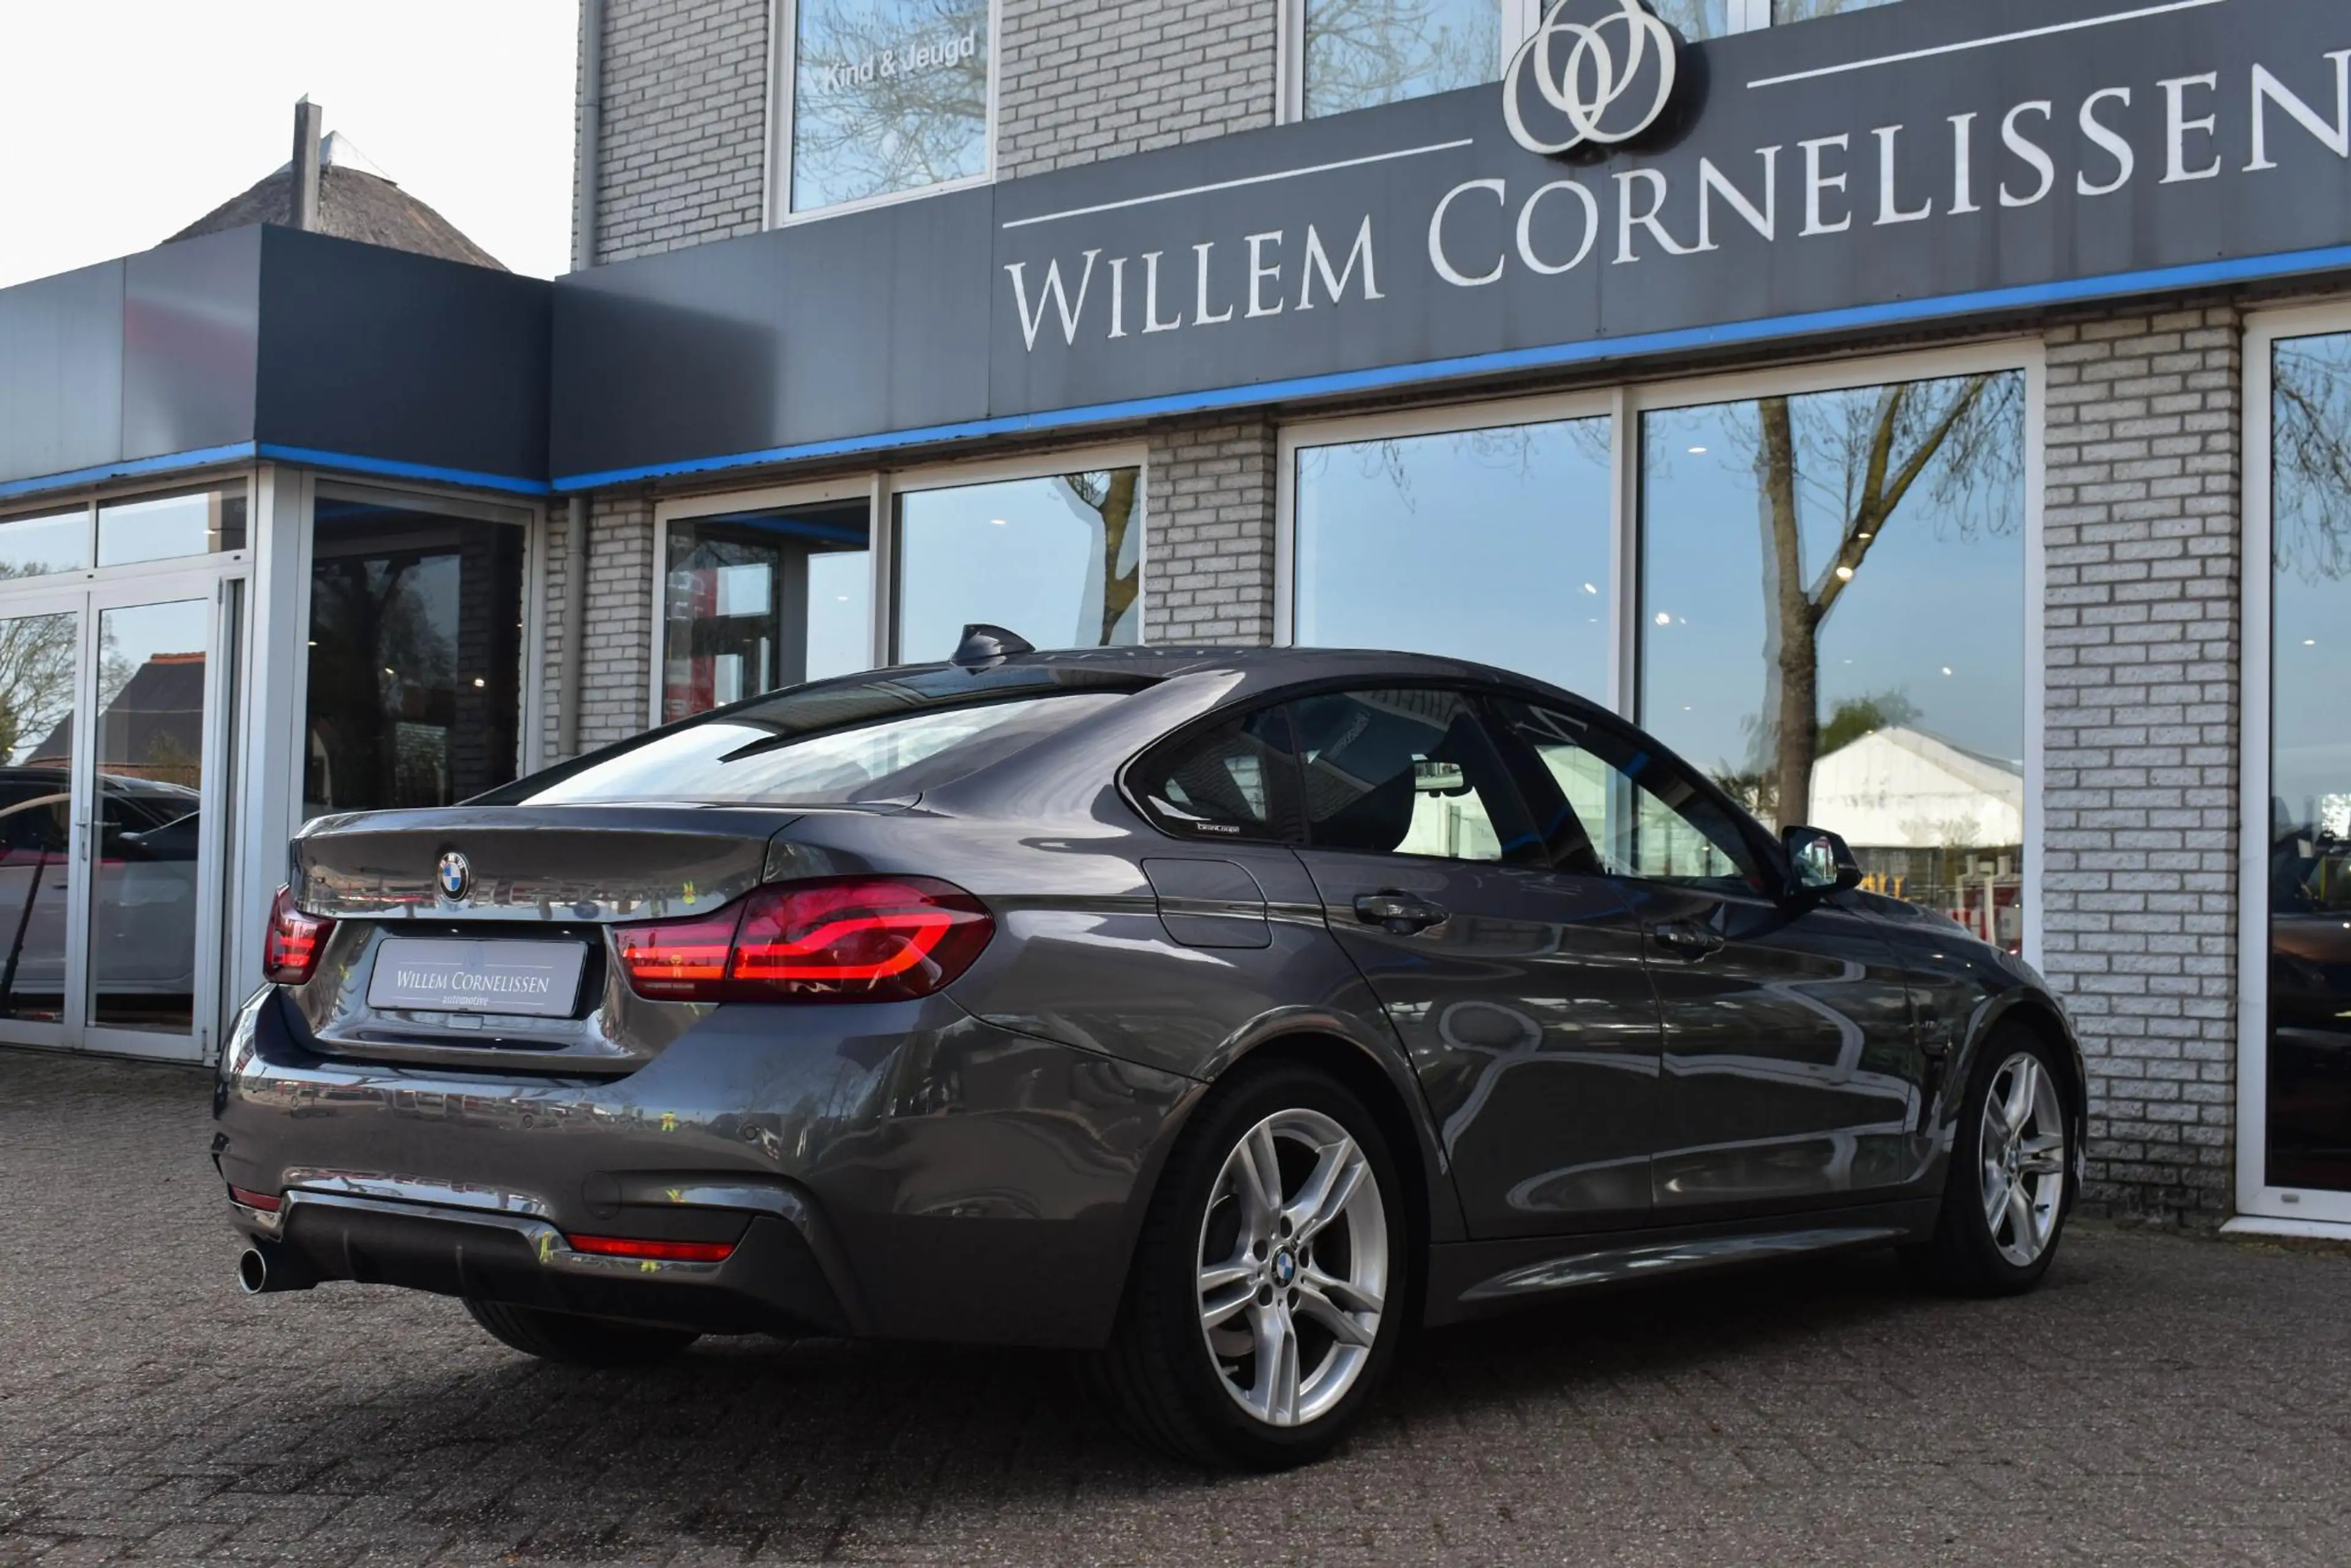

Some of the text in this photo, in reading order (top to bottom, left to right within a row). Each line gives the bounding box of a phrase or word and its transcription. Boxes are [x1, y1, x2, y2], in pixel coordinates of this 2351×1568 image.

[824, 28, 975, 91] Kind & Jeugd
[1003, 49, 2351, 353] WILLEM CORNELISSEN
[397, 970, 550, 994] WILLEM CORNELISSEN
[441, 994, 489, 1007] automotive
